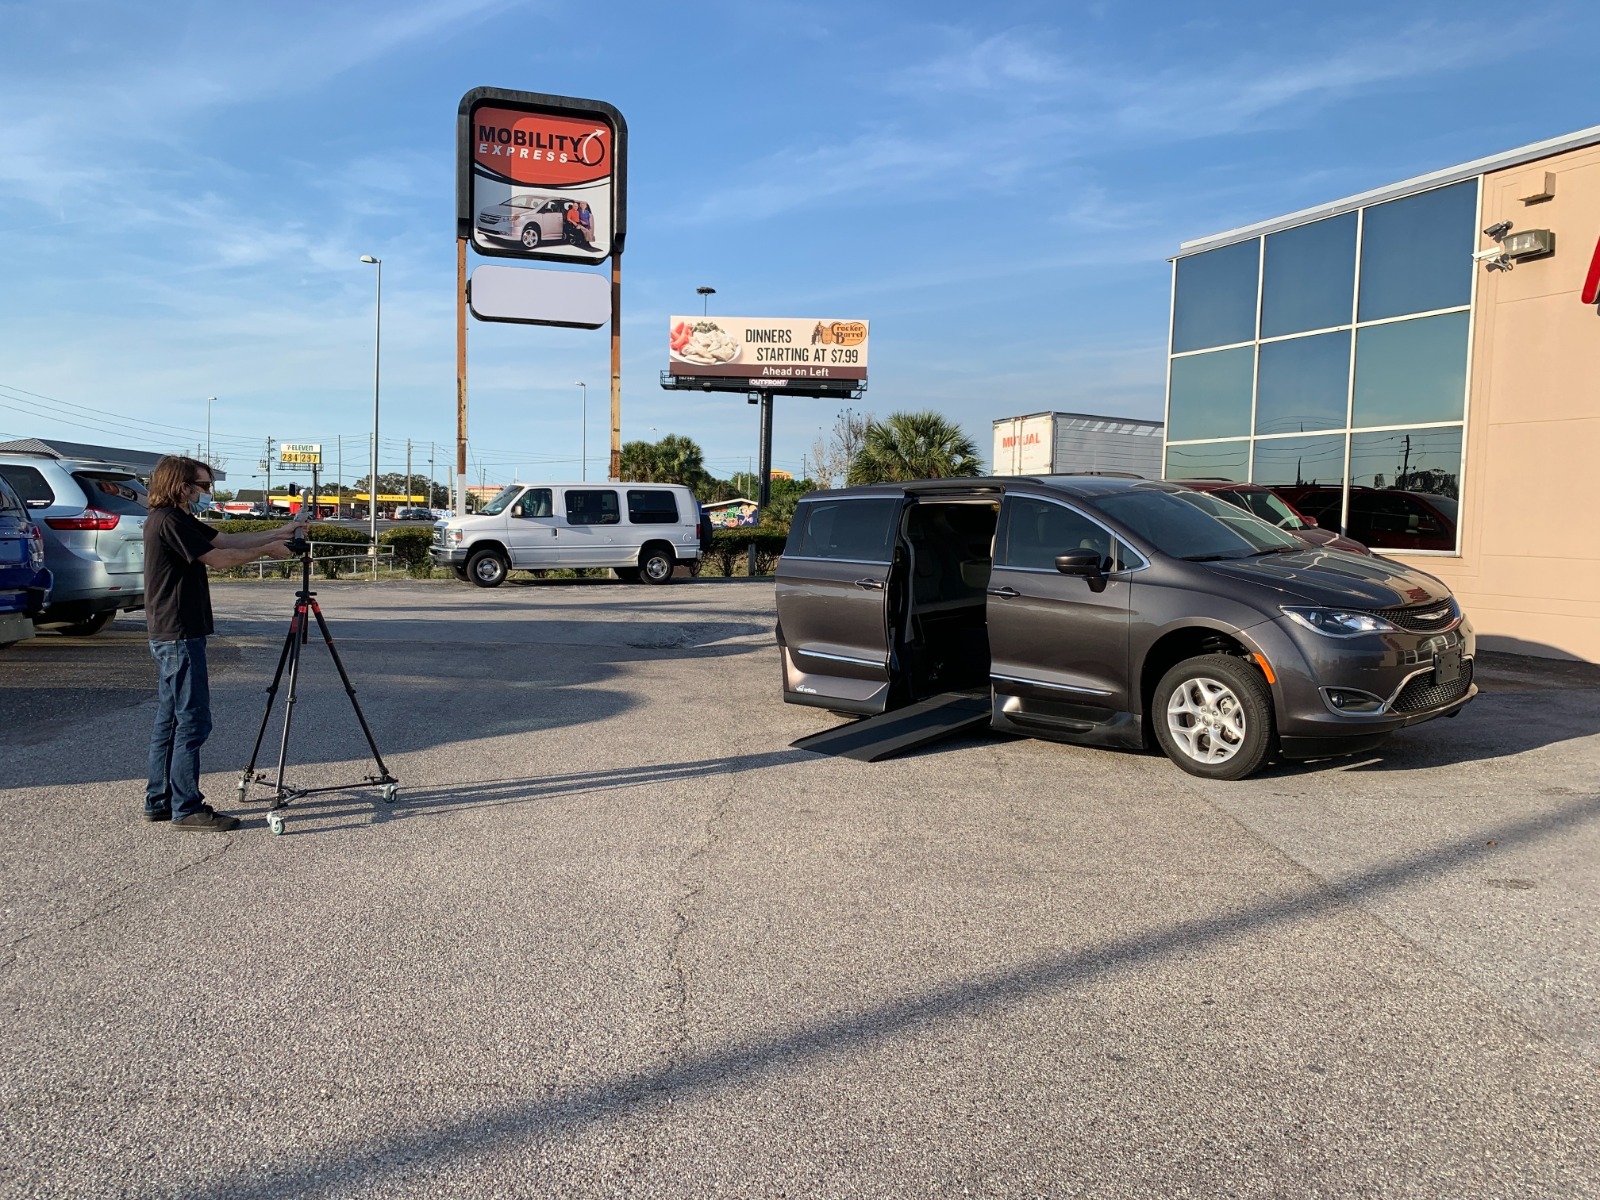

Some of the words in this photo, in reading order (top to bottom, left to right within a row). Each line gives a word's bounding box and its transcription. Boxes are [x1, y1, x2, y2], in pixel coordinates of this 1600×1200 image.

[479, 125, 582, 152] MOBILITY
[479, 143, 568, 163] EXPRESS
[745, 328, 792, 344] DINNERS
[831, 322, 863, 337] Cracker
[836, 331, 863, 344] Barrel
[756, 347, 809, 362] STARTING
[813, 348, 827, 362] AT
[831, 348, 858, 363] $7.99
[762, 366, 792, 376] Ahead
[810, 367, 829, 376] Left
